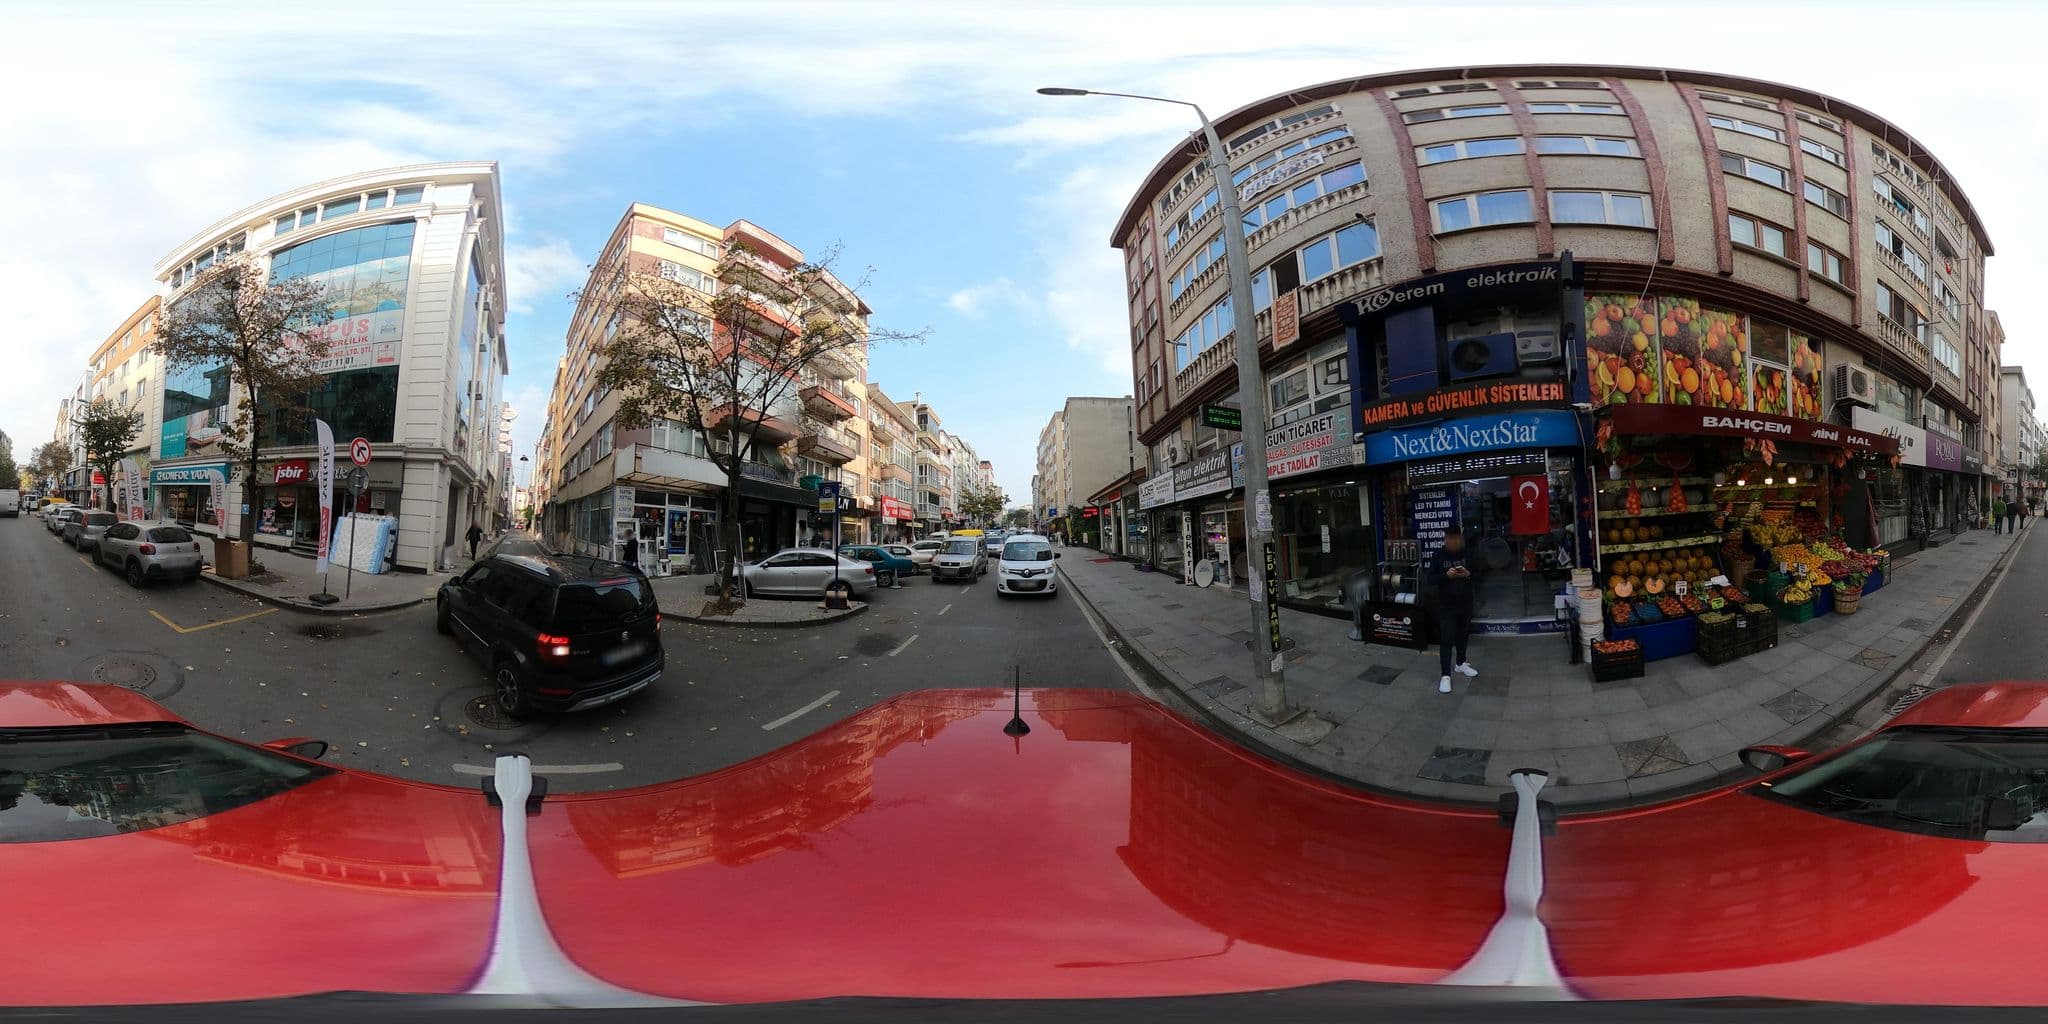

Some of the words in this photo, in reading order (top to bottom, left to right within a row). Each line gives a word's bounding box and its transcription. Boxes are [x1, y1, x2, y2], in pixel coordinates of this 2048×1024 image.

[1364, 402, 1408, 424] KAMERA
[1412, 402, 1424, 415] ve
[1427, 385, 1487, 412] GÜVENLİK
[1491, 381, 1563, 403] SİSTEMLERİ
[1265, 431, 1286, 448] GUN
[1288, 415, 1334, 441] TİCARET
[1702, 416, 1792, 434] BAHÇEM
[1847, 435, 1871, 446] HAL
[1193, 451, 1227, 477] elektrik
[1266, 447, 1287, 460] ALGAZ
[1267, 463, 1285, 476] MPLE
[1287, 454, 1319, 472] TADİLAT
[161, 471, 189, 481] KONFOR
[1184, 517, 1193, 583] elektrik
[1268, 580, 1276, 594] TV
